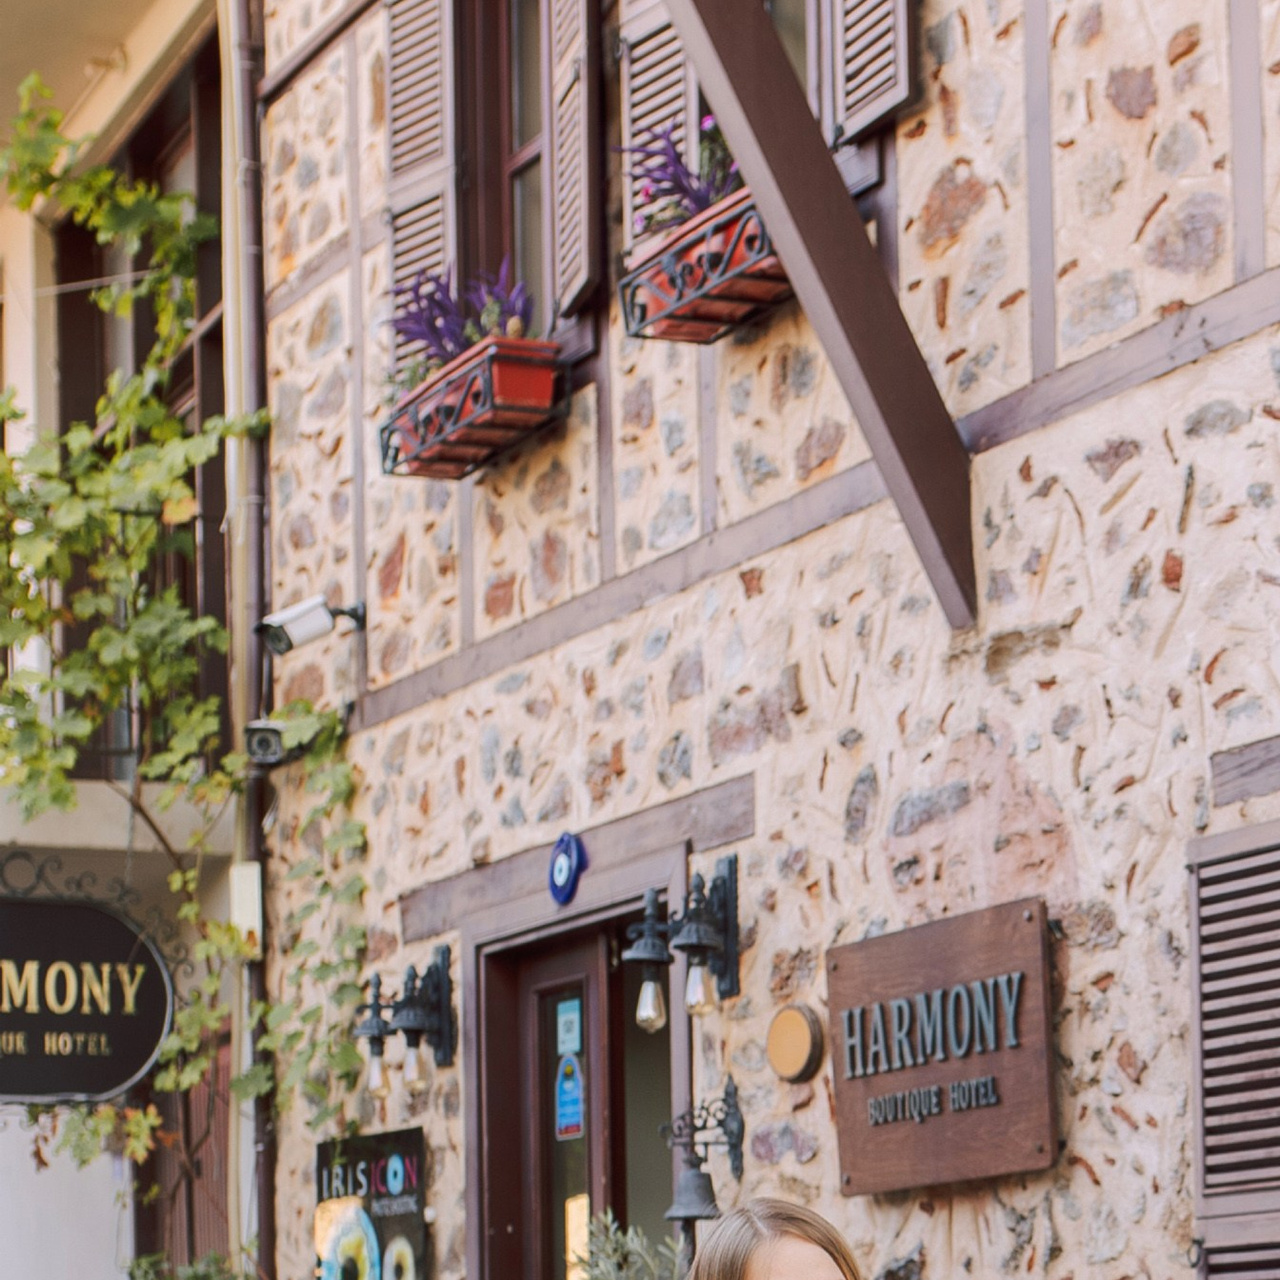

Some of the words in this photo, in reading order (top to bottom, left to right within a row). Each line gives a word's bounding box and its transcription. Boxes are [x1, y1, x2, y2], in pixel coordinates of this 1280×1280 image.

[44, 1031, 110, 1056] HOTEL
[841, 971, 1023, 1079] HARMONY
[868, 1084, 941, 1126] BOUTIQUE
[949, 1076, 998, 1112] HOTEL
